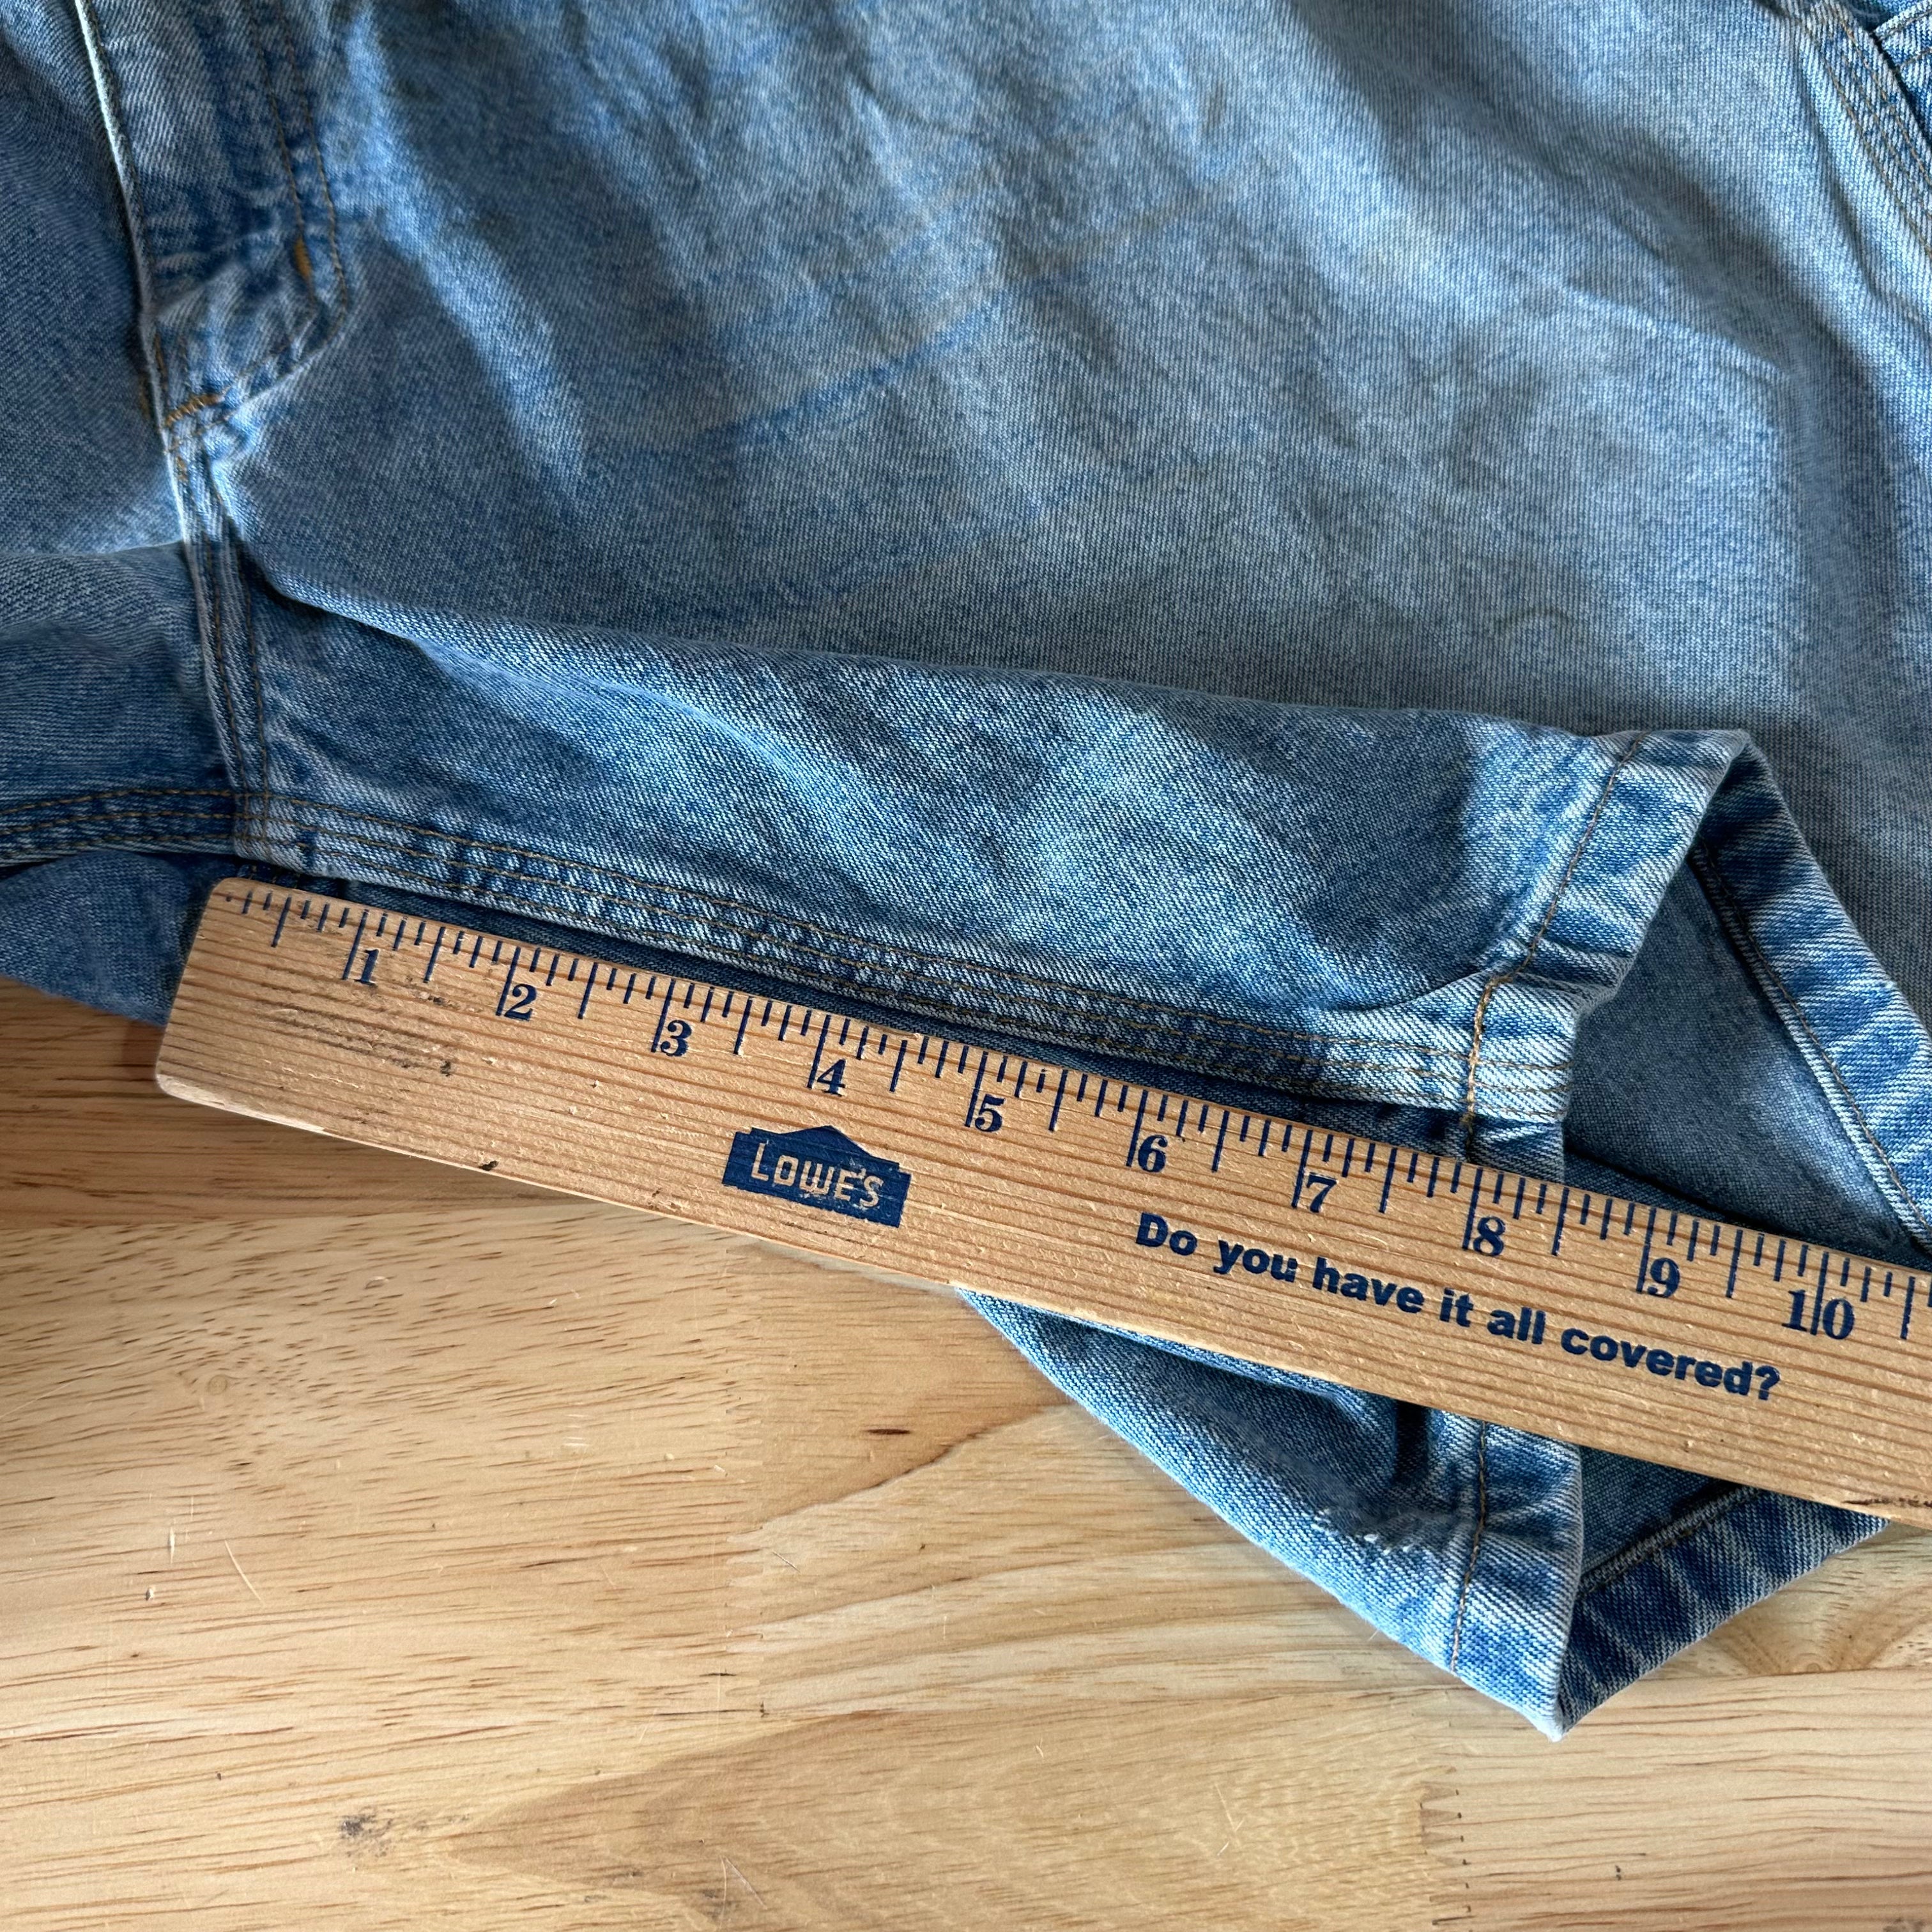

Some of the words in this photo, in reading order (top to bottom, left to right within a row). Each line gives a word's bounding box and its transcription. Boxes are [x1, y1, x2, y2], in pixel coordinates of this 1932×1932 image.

[357, 948, 380, 986] 1
[505, 983, 538, 1021] 2
[661, 1020, 693, 1058] 3
[816, 1058, 847, 1096] 4
[974, 1094, 1006, 1133] 5
[1138, 1135, 1168, 1173] 6
[1305, 1172, 1338, 1213] 7
[1473, 1216, 1505, 1257] 8
[1647, 1257, 1681, 1298] 9
[1782, 1289, 1855, 1340] 10
[751, 1142, 885, 1209] LOWE'S
[1135, 1211, 1198, 1256] Do
[1213, 1239, 1298, 1284] you
[1312, 1256, 1425, 1314] have
[1439, 1287, 1475, 1328] it
[1487, 1307, 1546, 1344] all
[1560, 1327, 1781, 1401] covered?
